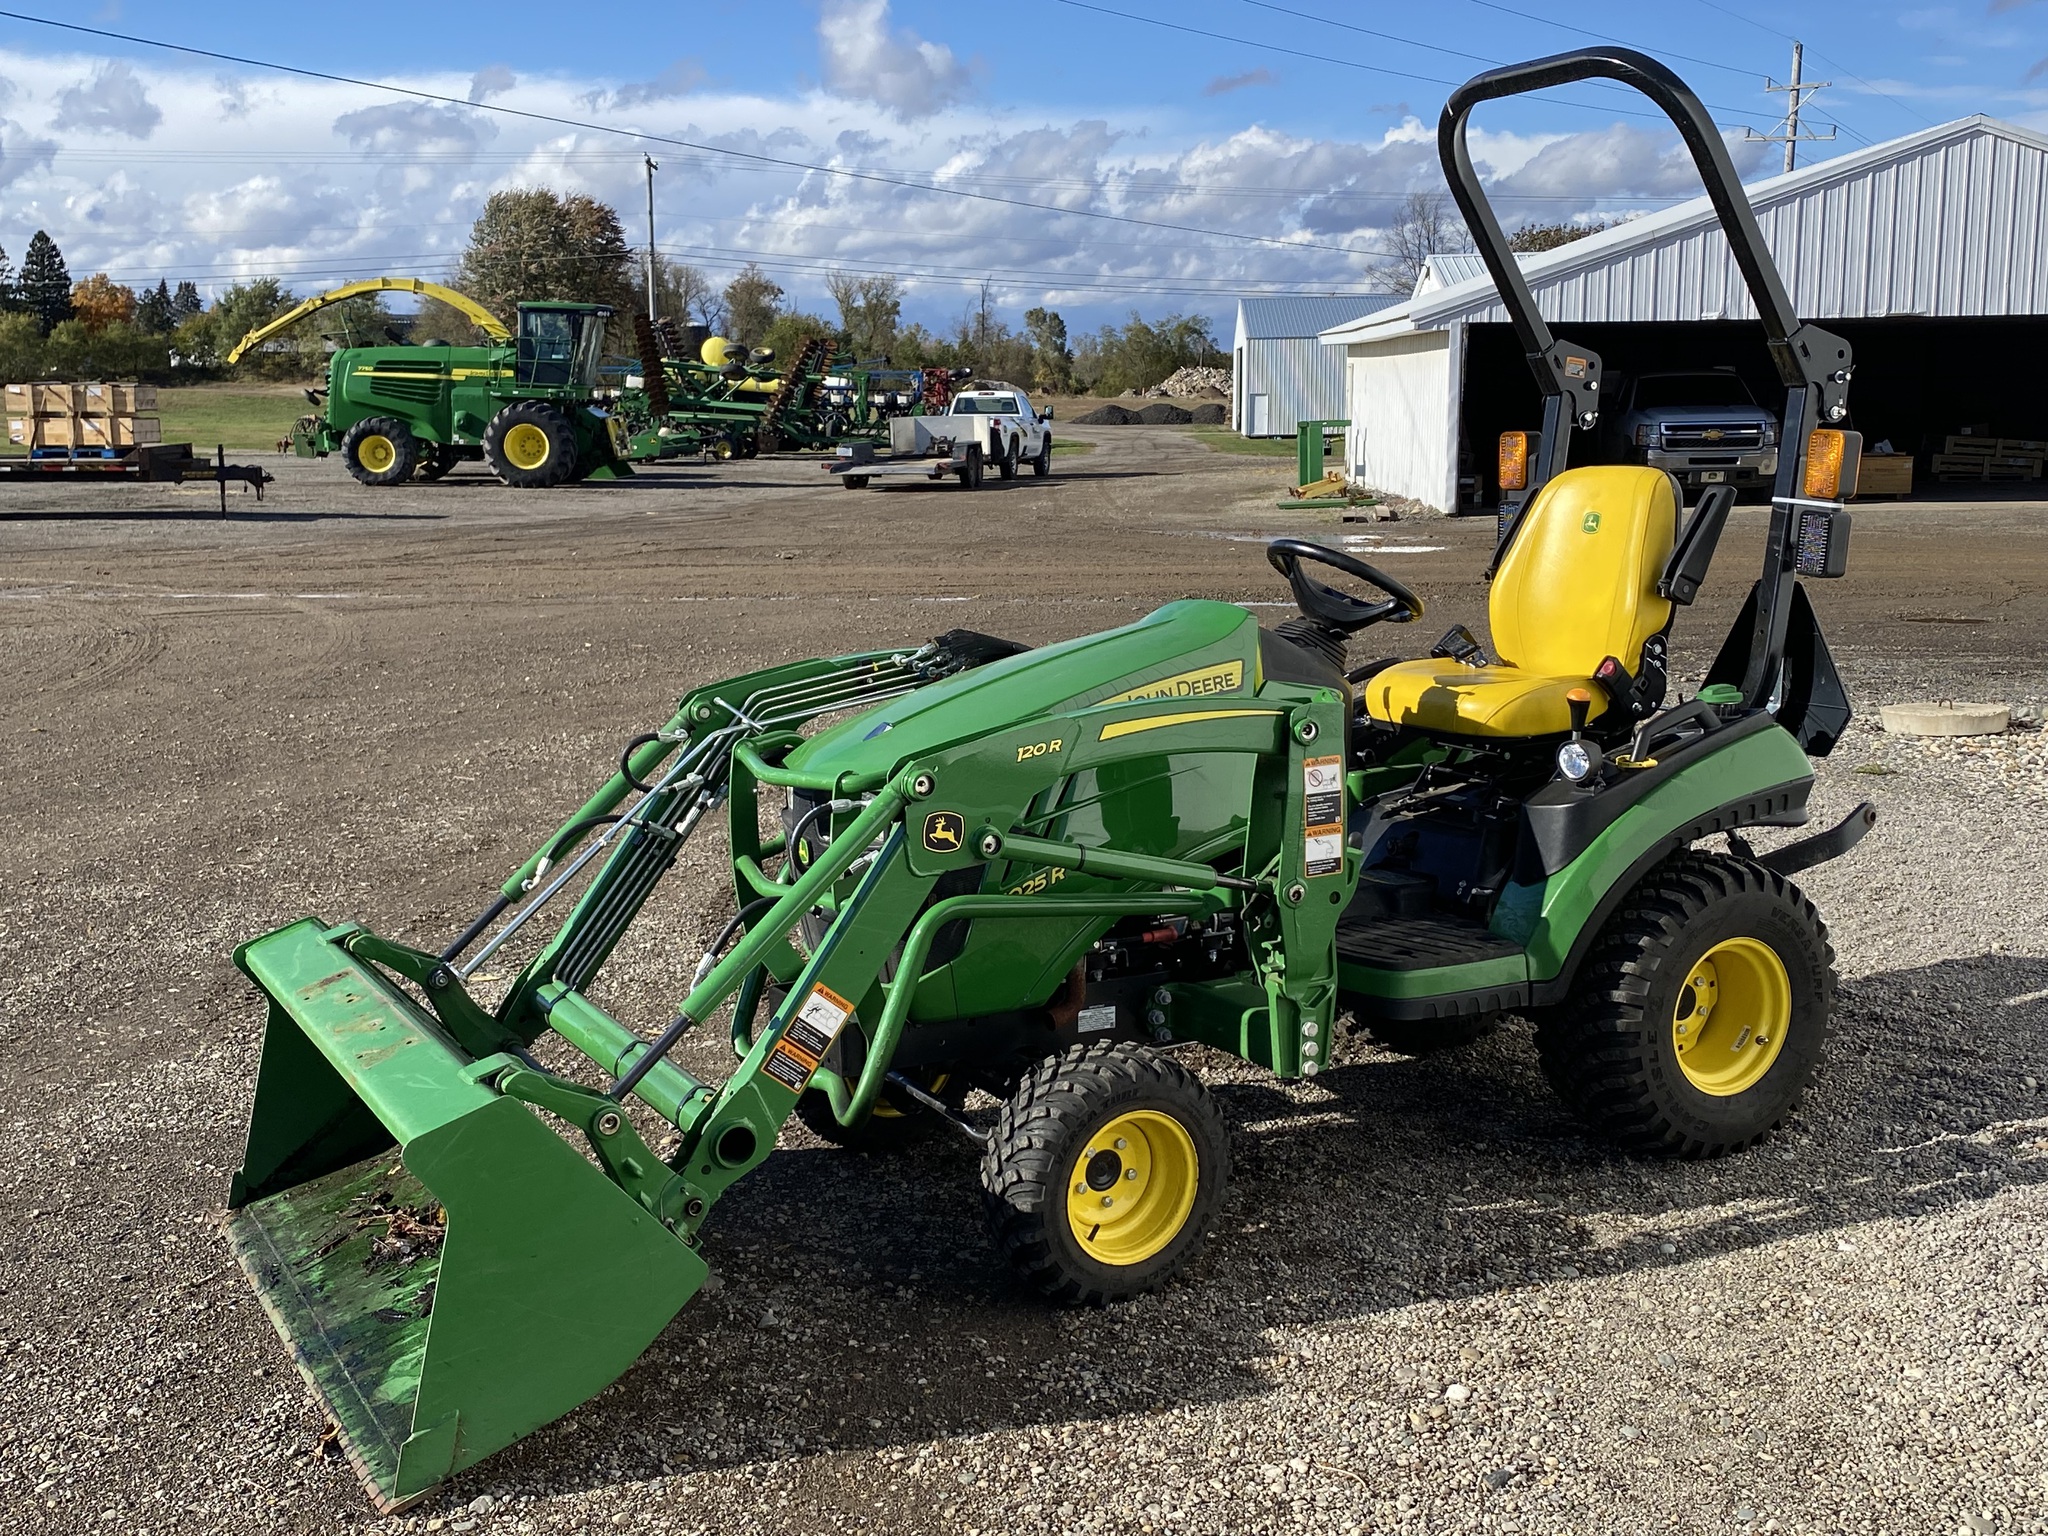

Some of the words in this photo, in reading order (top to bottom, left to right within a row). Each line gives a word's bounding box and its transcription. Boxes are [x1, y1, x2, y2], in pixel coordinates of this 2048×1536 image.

[1176, 672, 1236, 697] DEERE
[1017, 743, 1048, 763] 120
[1048, 739, 1063, 754] R
[1312, 826, 1341, 836] WARNING
[1004, 872, 1048, 895] 025
[1051, 867, 1066, 885] R
[1771, 906, 1813, 951] VERSA
[1808, 951, 1823, 1003] TURF
[823, 991, 849, 1011] WARNING
[787, 1048, 813, 1068] WARNING
[1648, 1030, 1710, 1132] CARLISLE
